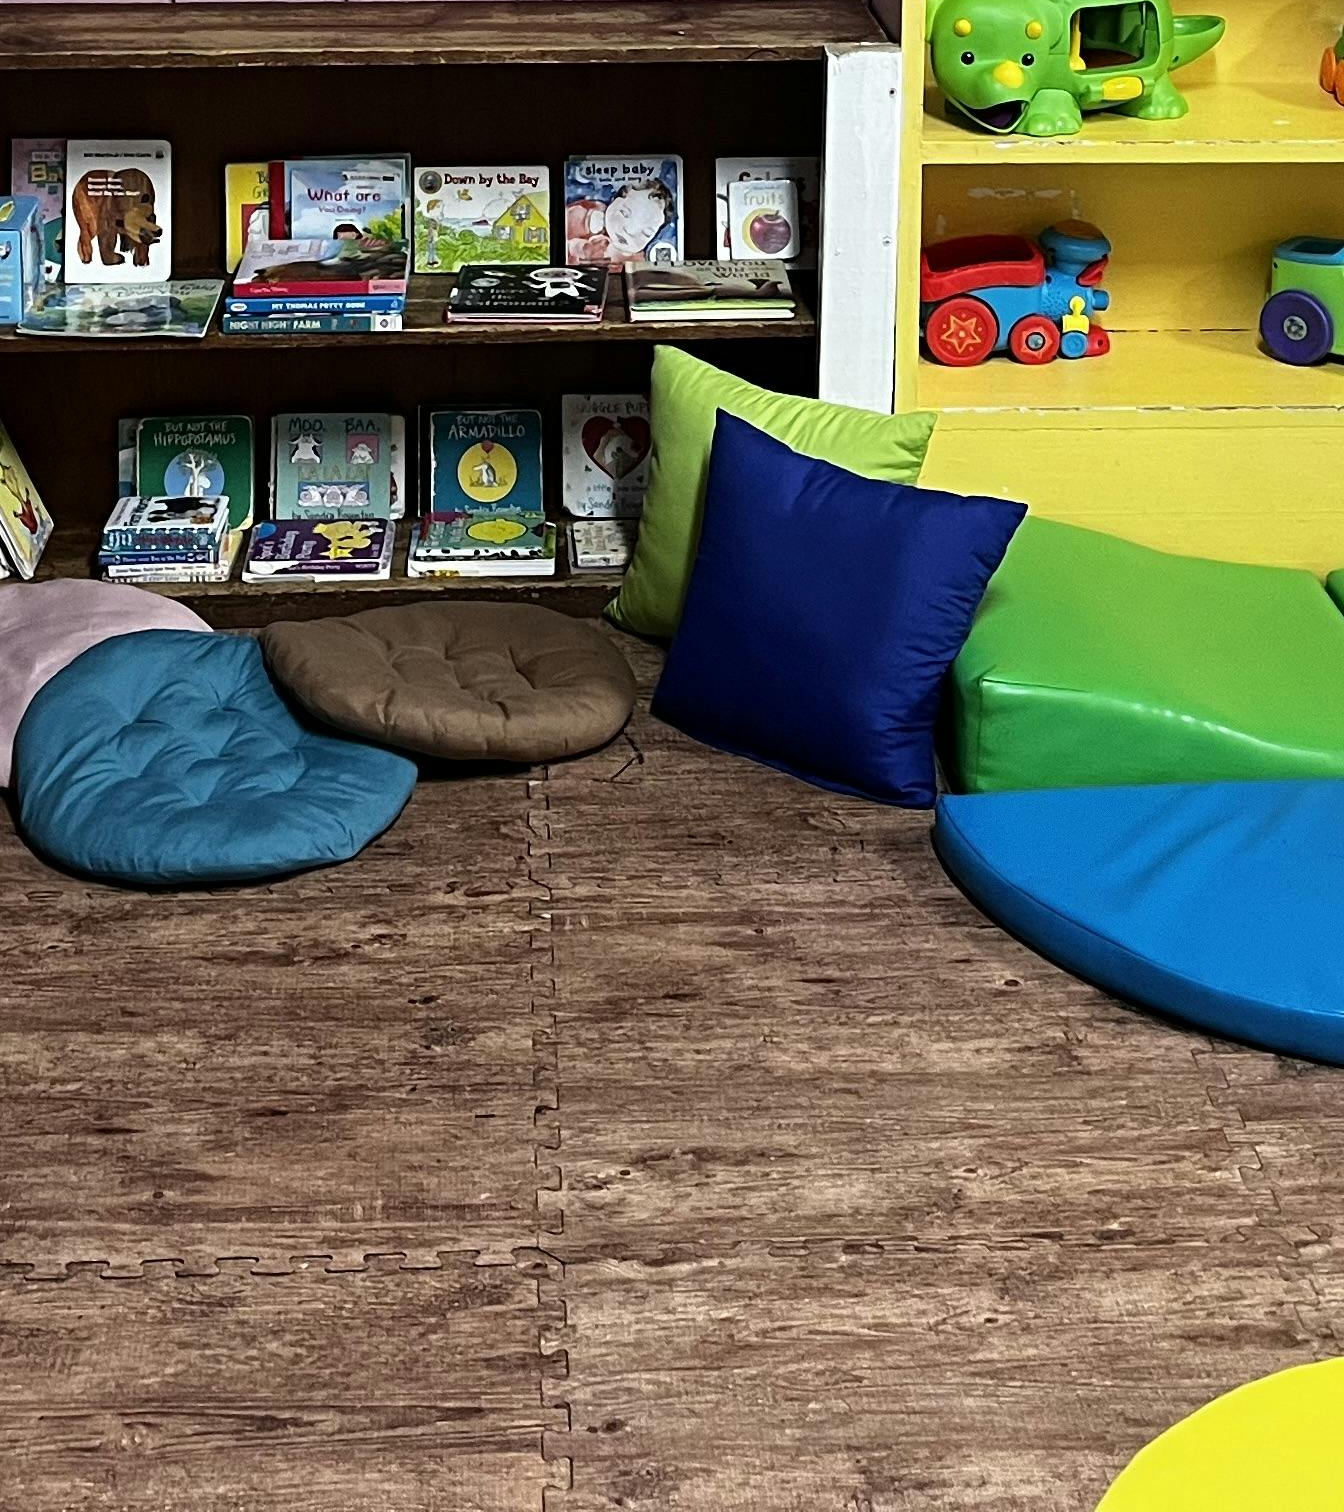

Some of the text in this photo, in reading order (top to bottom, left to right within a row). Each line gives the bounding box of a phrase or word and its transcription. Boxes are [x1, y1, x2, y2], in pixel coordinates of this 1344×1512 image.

[622, 162, 655, 176] baby
[444, 172, 539, 187] Down by the Bay
[307, 188, 381, 202] What are
[744, 190, 785, 206] fruits
[154, 431, 236, 447] HIPPOPOTAMUS
[448, 424, 526, 440] ARMADILLO
